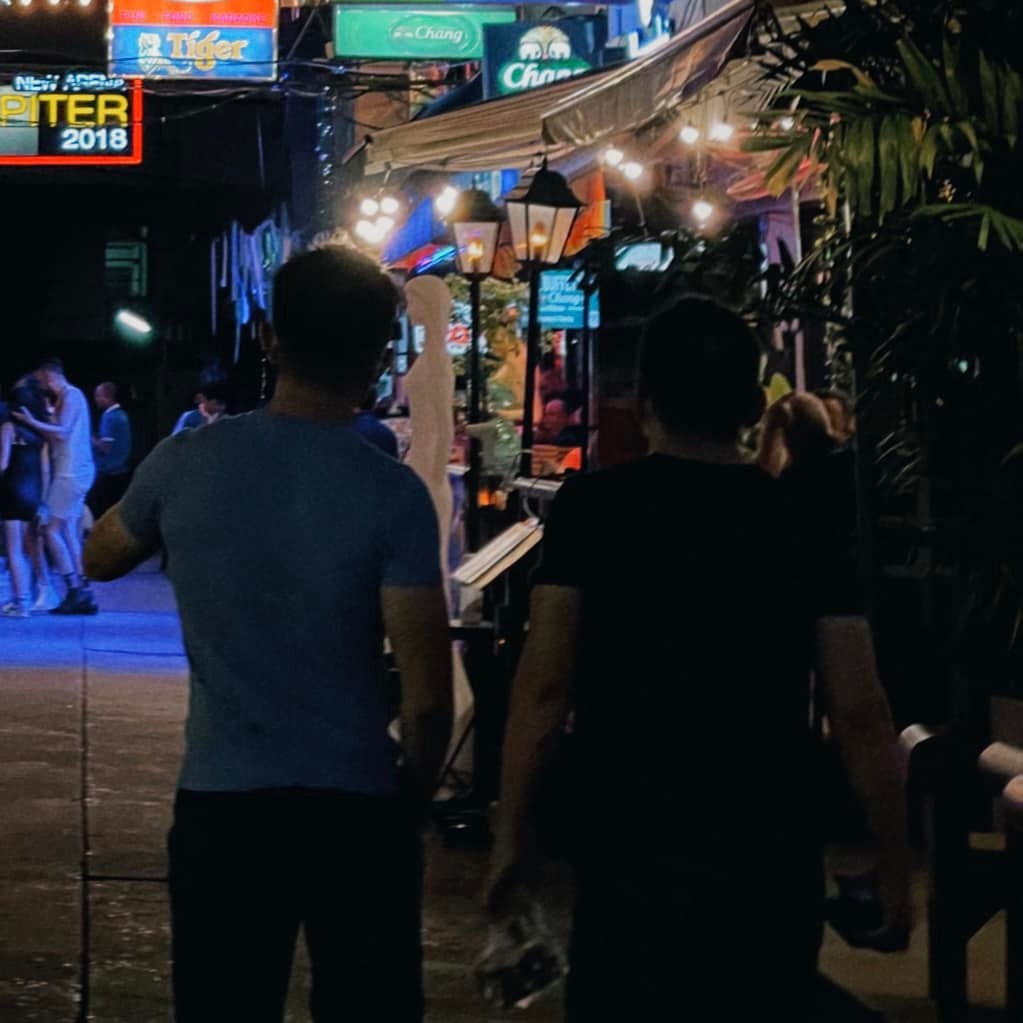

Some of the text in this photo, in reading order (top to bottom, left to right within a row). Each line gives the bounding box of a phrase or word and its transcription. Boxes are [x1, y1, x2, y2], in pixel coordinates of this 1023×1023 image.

[414, 25, 464, 44] Chang
[165, 29, 249, 72] Tiger
[60, 128, 128, 151] 2018
